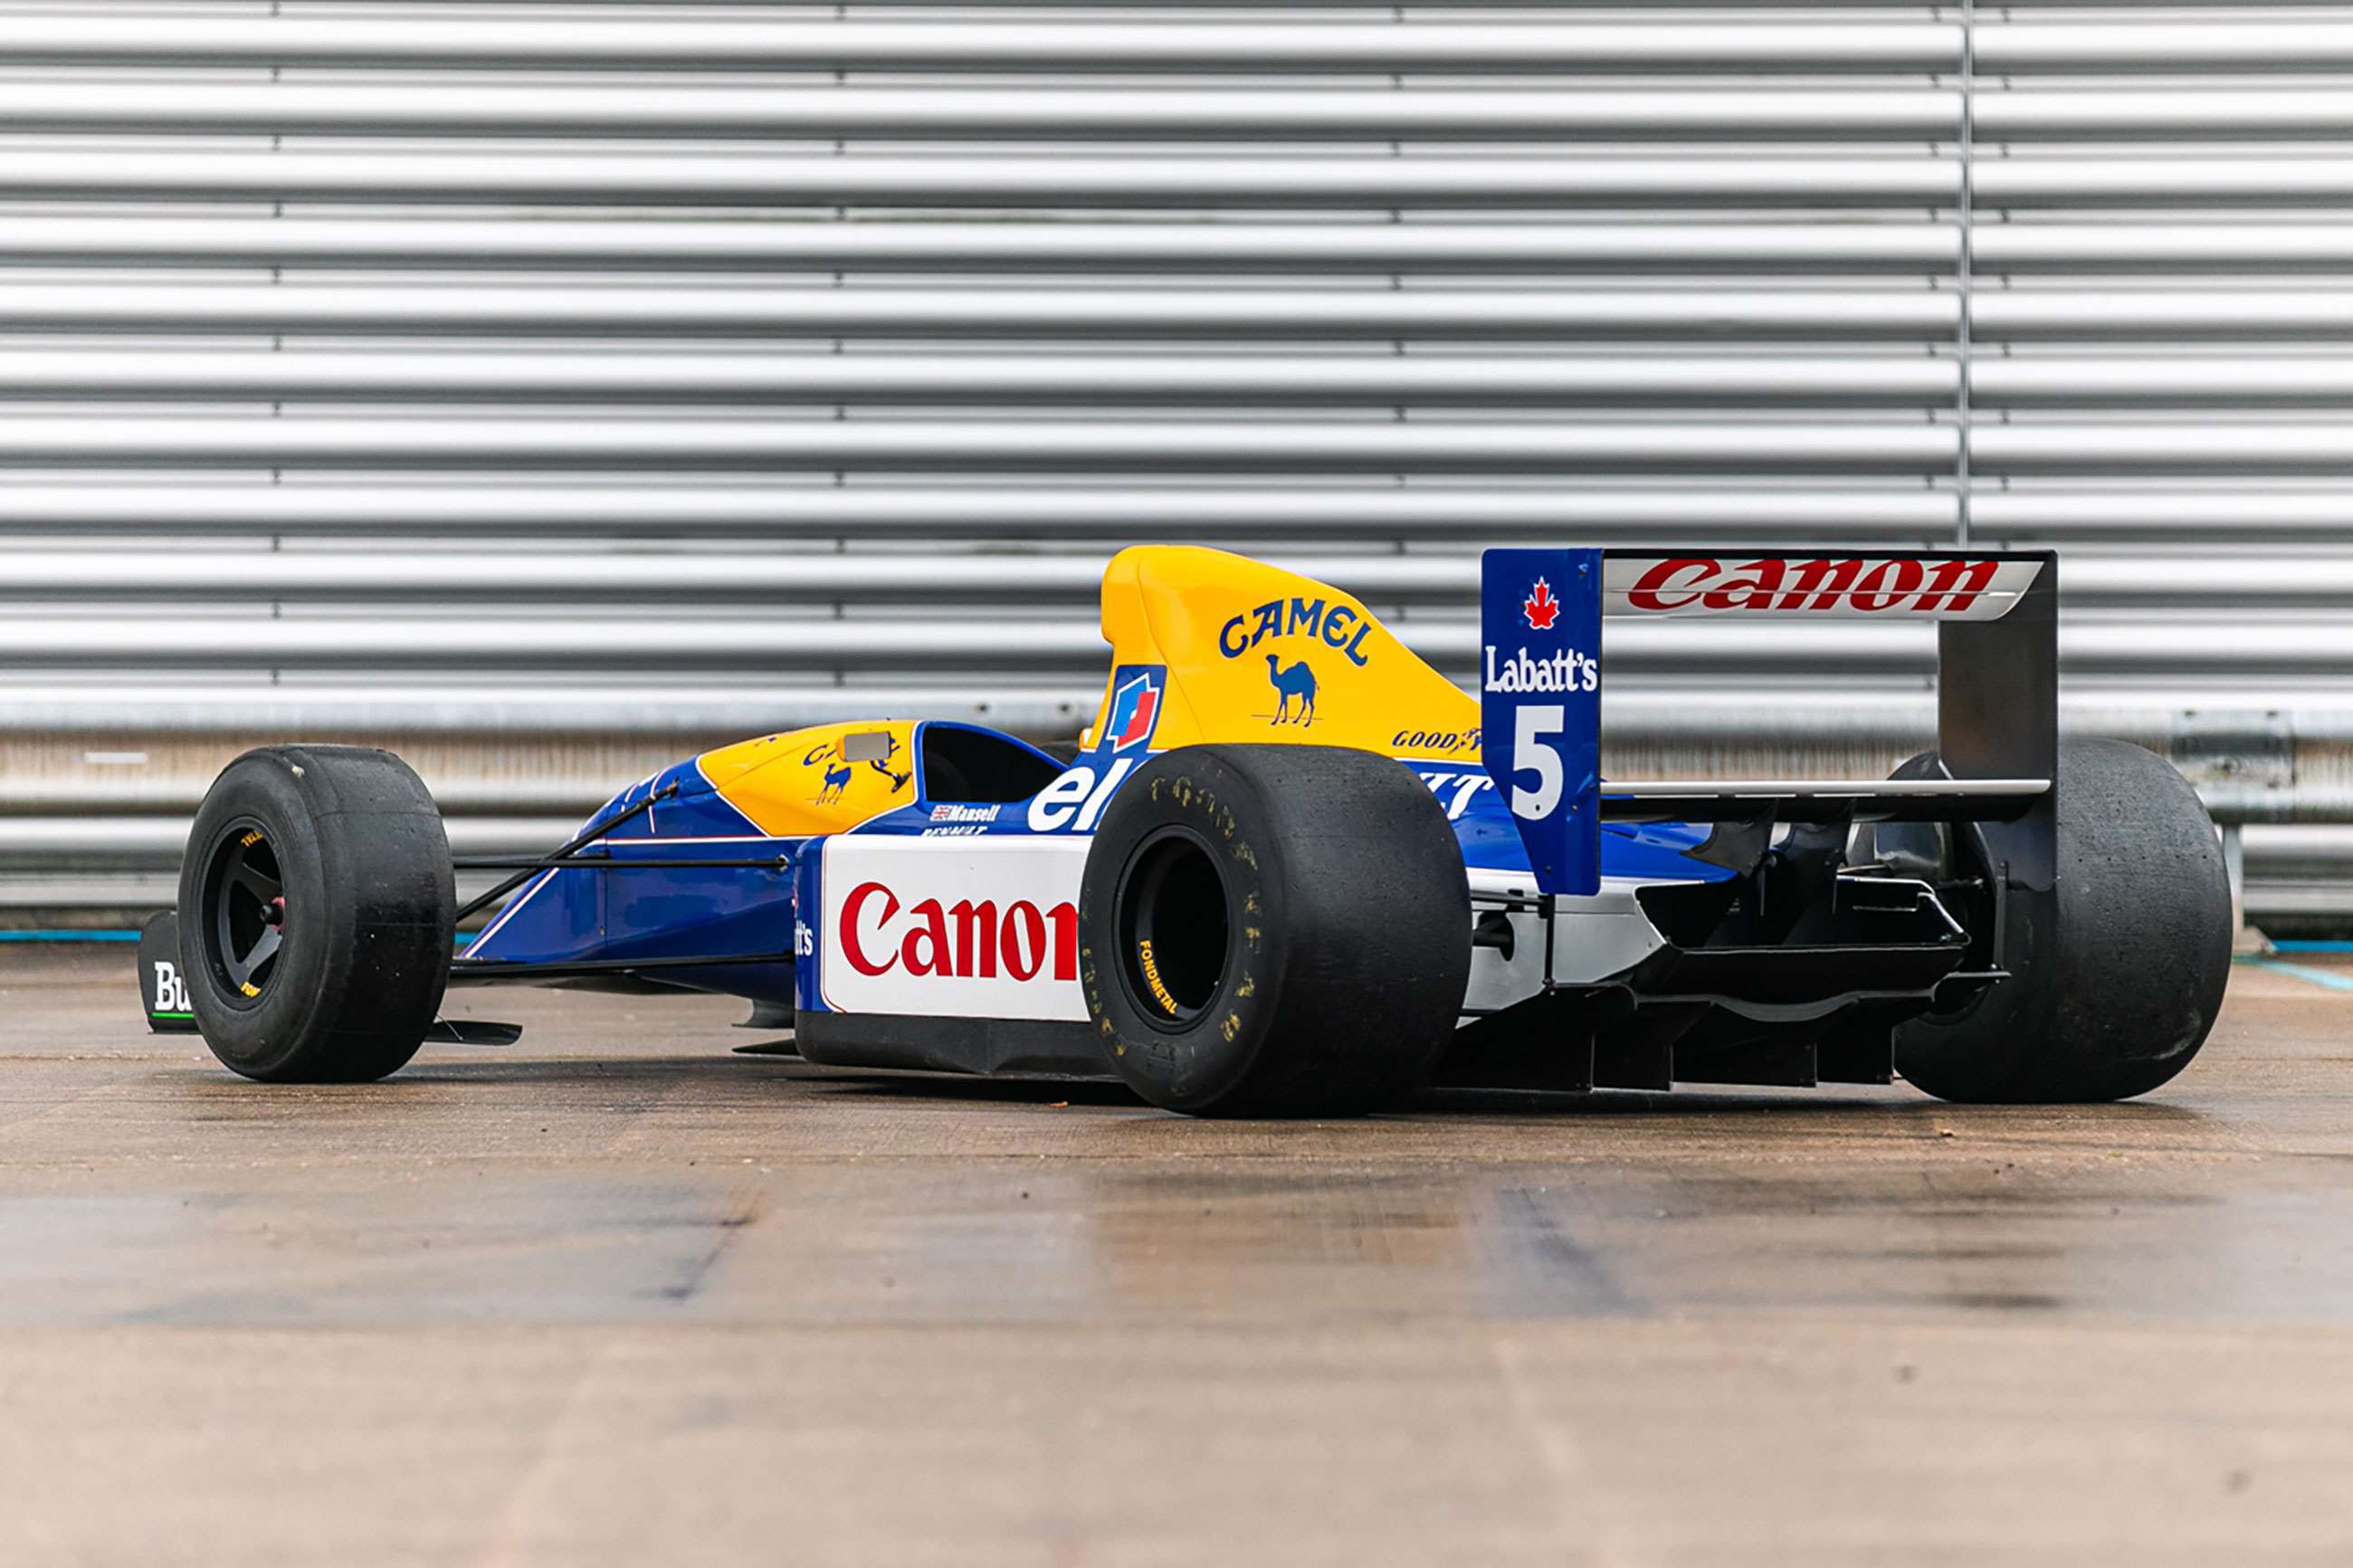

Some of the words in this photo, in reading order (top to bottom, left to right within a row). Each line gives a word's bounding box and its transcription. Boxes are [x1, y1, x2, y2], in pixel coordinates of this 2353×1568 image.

[1628, 558, 1998, 612] Canon
[1219, 597, 1372, 668] CAMEL
[1484, 644, 1598, 693] Labatt's
[1027, 757, 1134, 832] el
[1511, 705, 1565, 821] 5
[948, 804, 1001, 822] Mansell
[1139, 940, 1178, 1014] FONDMETAL
